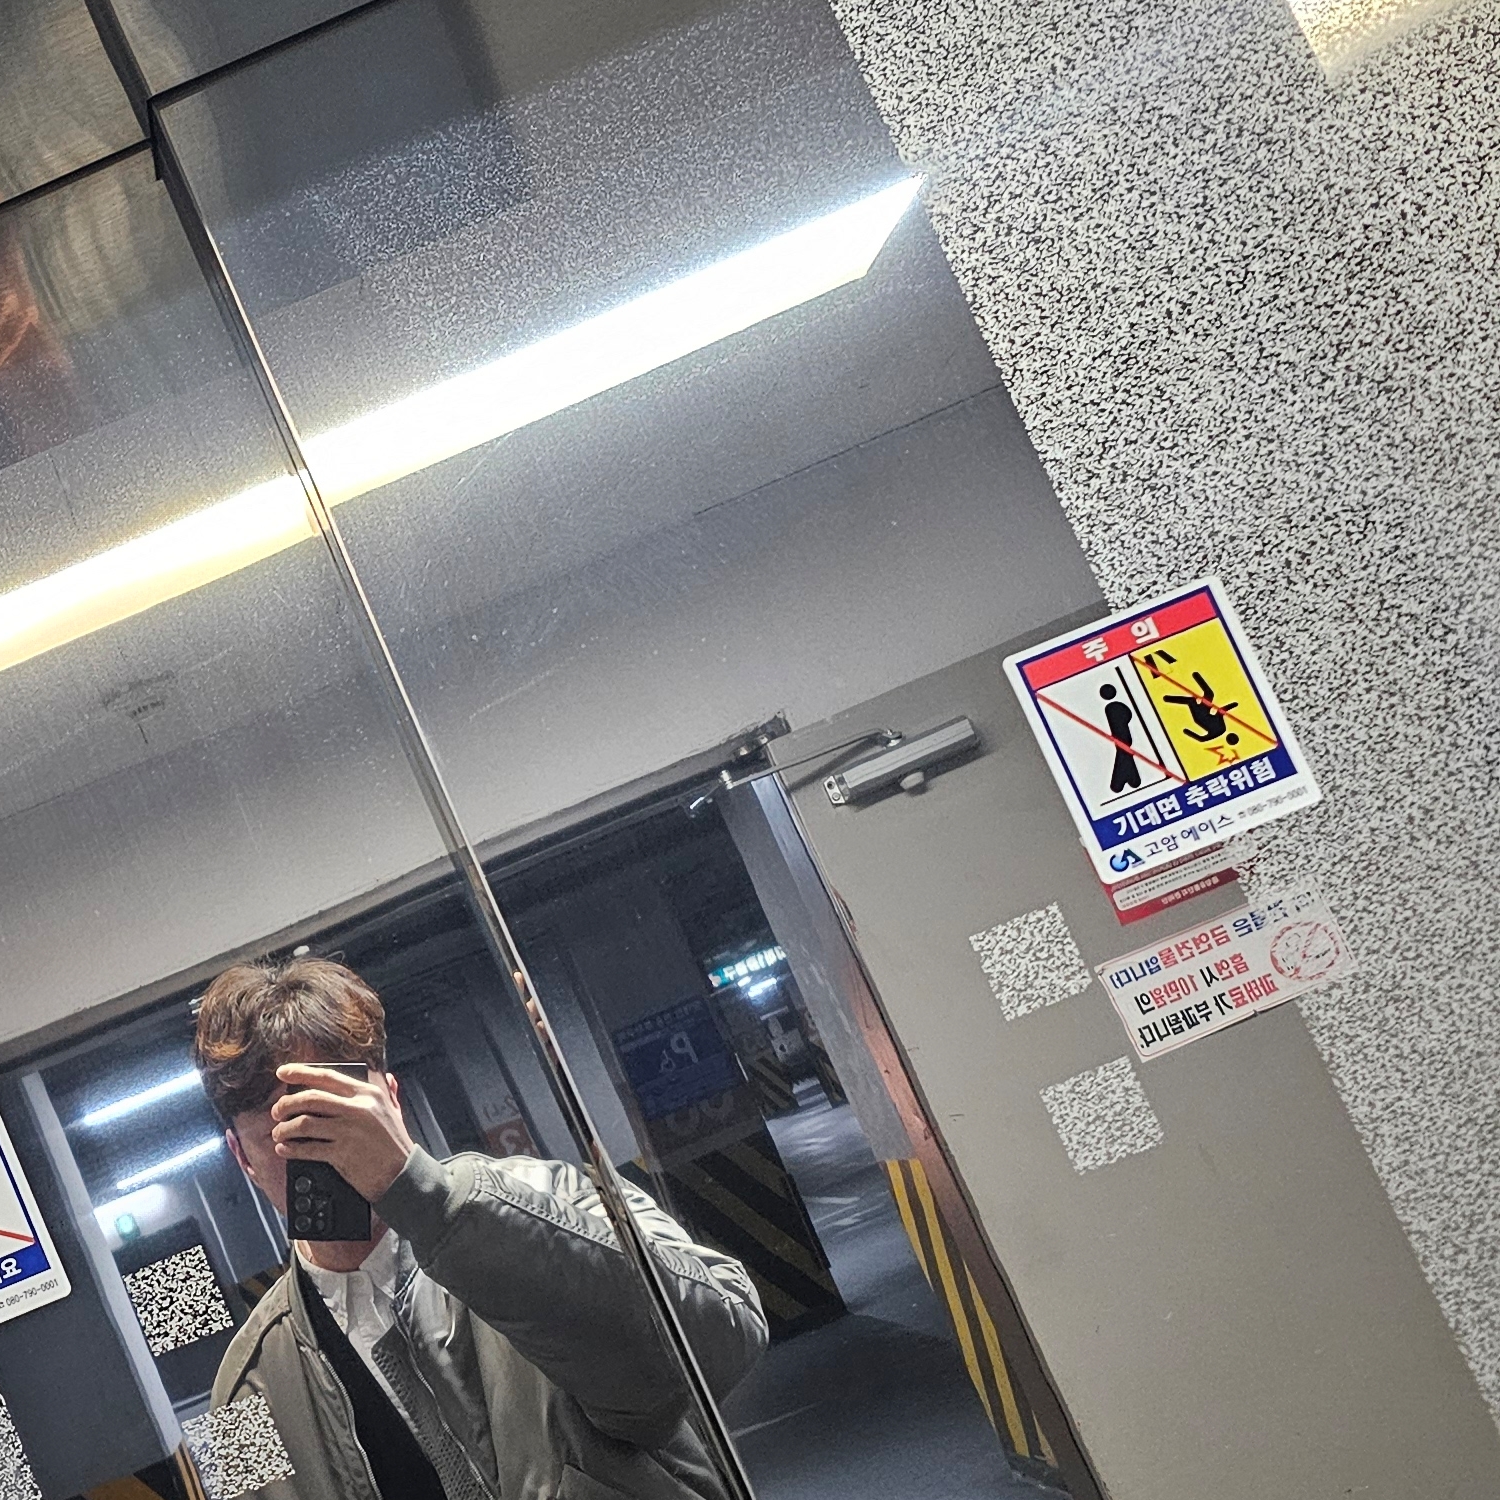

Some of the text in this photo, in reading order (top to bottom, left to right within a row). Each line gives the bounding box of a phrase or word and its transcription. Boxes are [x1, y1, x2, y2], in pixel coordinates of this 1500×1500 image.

[1081, 615, 1161, 662] 주 의
[1112, 755, 1277, 836] 기대면 추락위험
